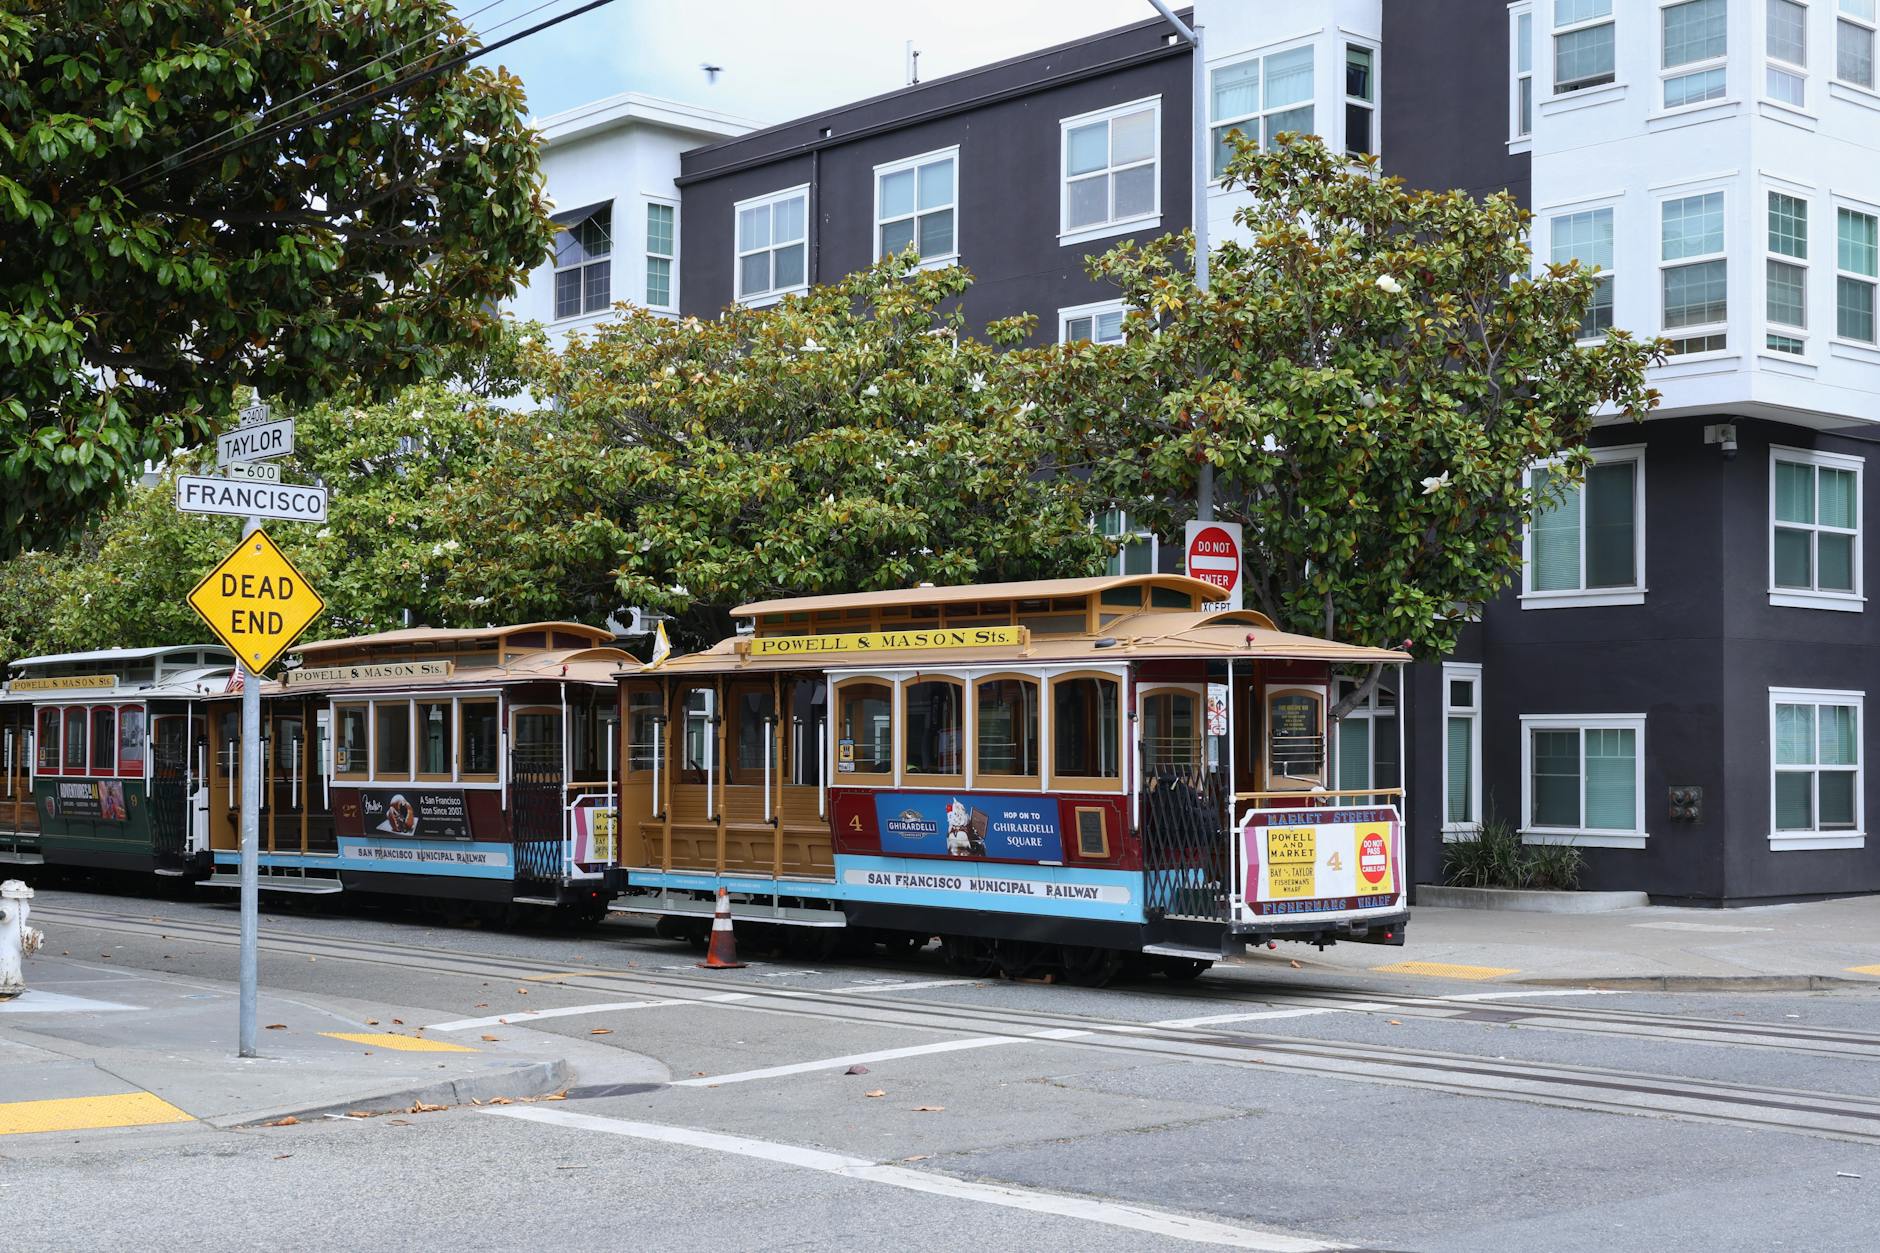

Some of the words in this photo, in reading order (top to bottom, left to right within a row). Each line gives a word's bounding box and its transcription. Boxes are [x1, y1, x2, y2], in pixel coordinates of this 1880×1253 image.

[247, 408, 265, 424] 2400
[225, 429, 282, 459] TAYLOR
[247, 465, 275, 479] 600
[186, 484, 321, 514] FRANCISCO
[1198, 541, 1211, 552] DO
[1213, 542, 1231, 553] NOT
[222, 573, 293, 600] DEAD
[232, 609, 283, 635] END
[762, 638, 848, 651] POWELL
[857, 636, 871, 648] &
[881, 632, 966, 647] MASON
[975, 630, 1010, 643] Sts.
[295, 670, 347, 681] POWELL
[351, 668, 359, 678] &
[364, 666, 414, 677] MASON
[422, 664, 442, 674] Sts.
[14, 680, 49, 690] POWELL
[62, 678, 95, 688] MASON
[60, 783, 89, 799] ADVENTURES
[130, 794, 138, 807] 9
[420, 796, 425, 804] A
[425, 796, 435, 804] San
[435, 796, 461, 805] Francisco
[421, 806, 433, 815] Icon
[433, 806, 448, 815] Since
[1004, 812, 1017, 820] HOP
[849, 814, 864, 831] 4
[1268, 813, 1322, 826] MARKET
[1333, 811, 1376, 823] STREET
[889, 821, 936, 831] GHIRARDELLI
[994, 822, 1054, 834] GHIRARDELLI
[1007, 836, 1043, 847] SQUARE
[1271, 833, 1313, 842] POWELL
[1363, 840, 1372, 848] DO
[358, 848, 372, 857] SAN
[374, 849, 413, 860] FRANCISCO
[416, 850, 455, 861] MUNICIPAL
[456, 852, 487, 863] RAILWAY
[1270, 849, 1315, 858] MARKET
[1326, 851, 1343, 871] 4
[1270, 867, 1281, 878] BAY
[1292, 867, 1313, 877] TAYLOR
[868, 873, 891, 885] SAN
[895, 874, 961, 889] FRANCISCO
[970, 879, 1034, 895] MUNICIPAL
[1046, 884, 1098, 899] RAILWAY
[1263, 900, 1346, 915] FISHERMANS
[1357, 896, 1391, 909] WHARF
